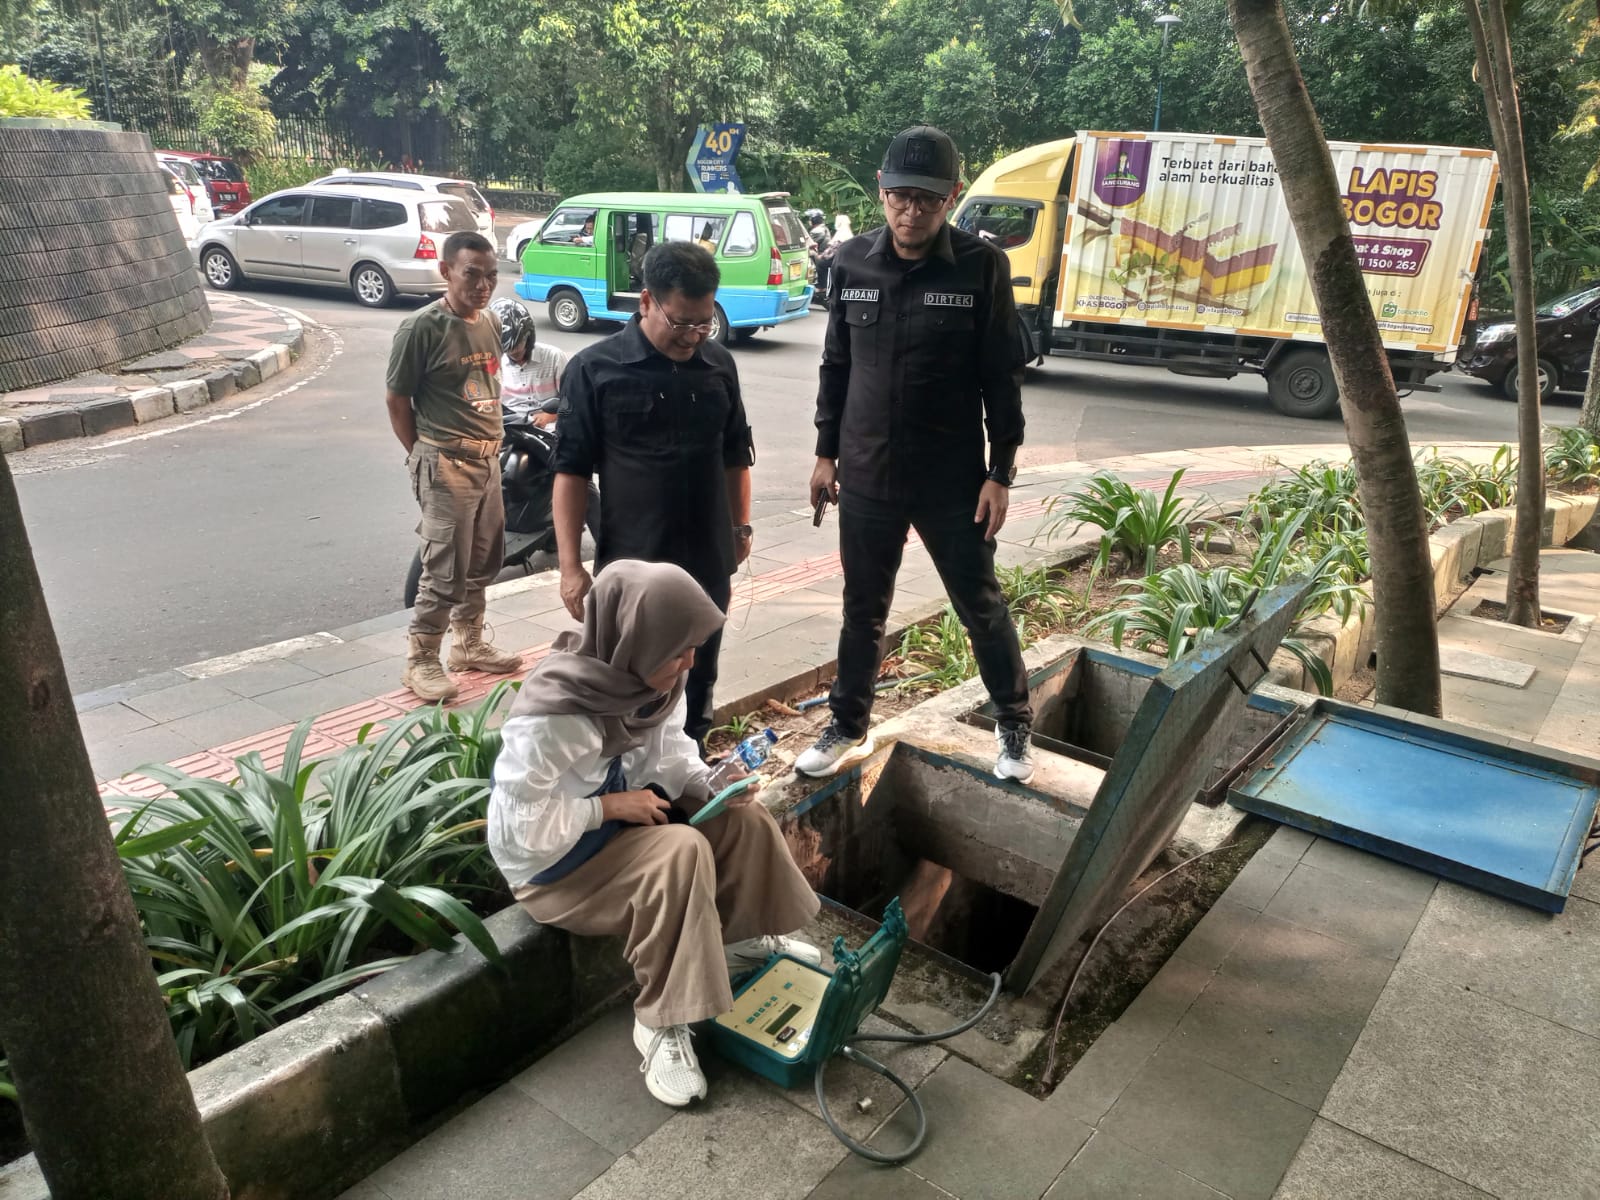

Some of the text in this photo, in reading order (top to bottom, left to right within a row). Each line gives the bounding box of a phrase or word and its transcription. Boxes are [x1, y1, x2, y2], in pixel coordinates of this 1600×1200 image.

[1162, 157, 1279, 174] Terbuat dari baha
[1159, 170, 1275, 187] alami berkualitas
[1349, 168, 1438, 198] LAPIS
[1370, 244, 1380, 254] &
[1368, 258, 1393, 269] 1500
[1395, 260, 1417, 271] 262
[843, 290, 877, 301] ARDANI
[926, 294, 971, 305] DIRTEK
[1098, 301, 1127, 310] BOGOR
